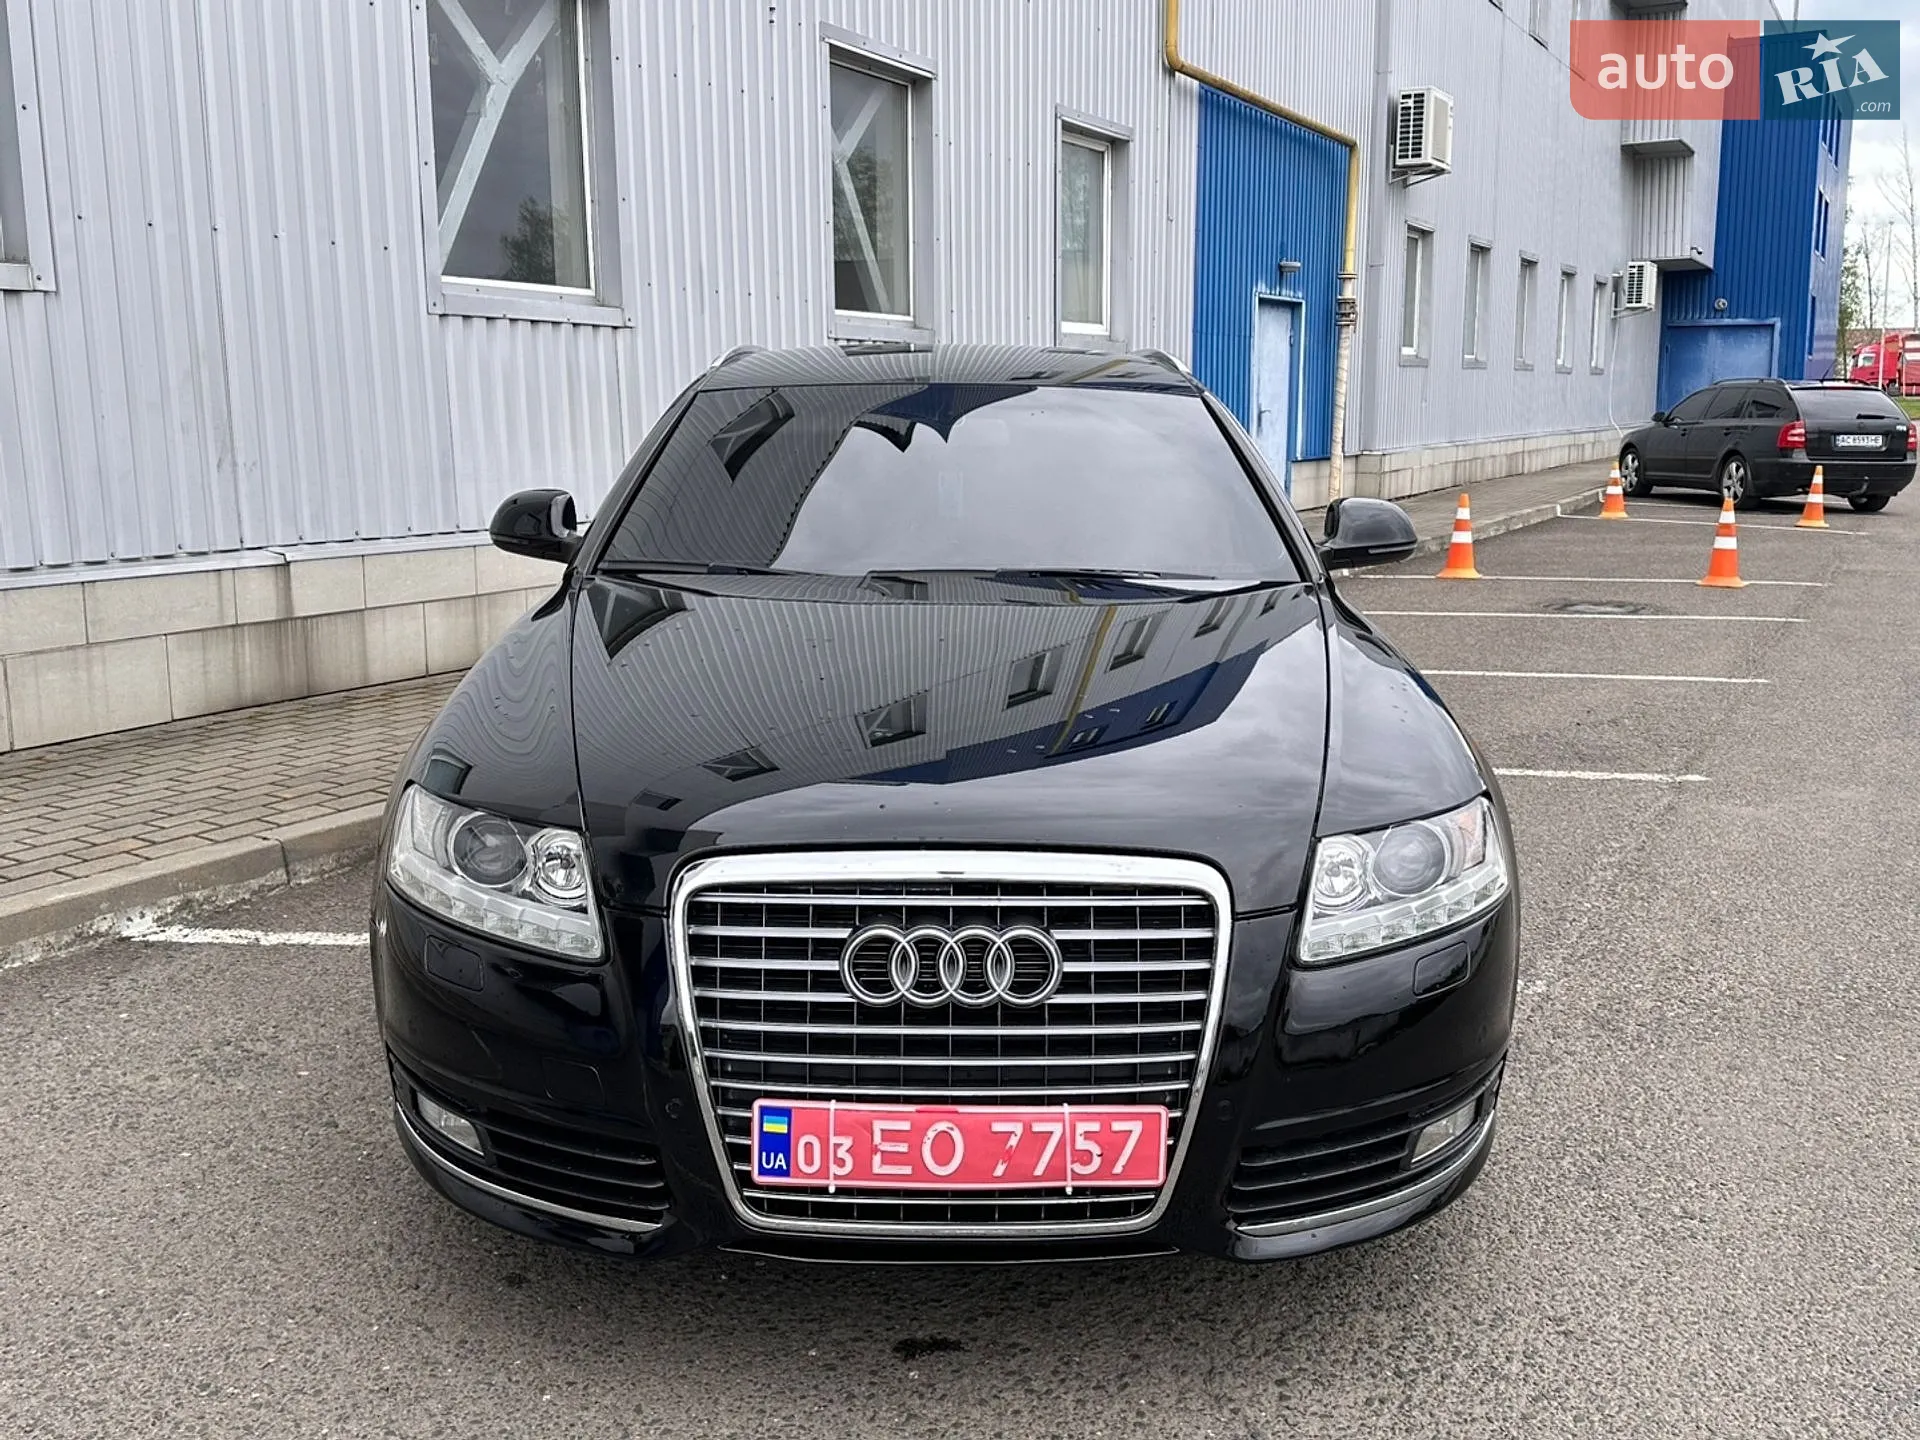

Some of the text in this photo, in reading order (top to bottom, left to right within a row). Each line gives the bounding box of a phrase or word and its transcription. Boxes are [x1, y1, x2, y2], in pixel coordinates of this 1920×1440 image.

[761, 1151, 788, 1171] UA
[796, 1119, 1144, 1177] 03 EO 7757
